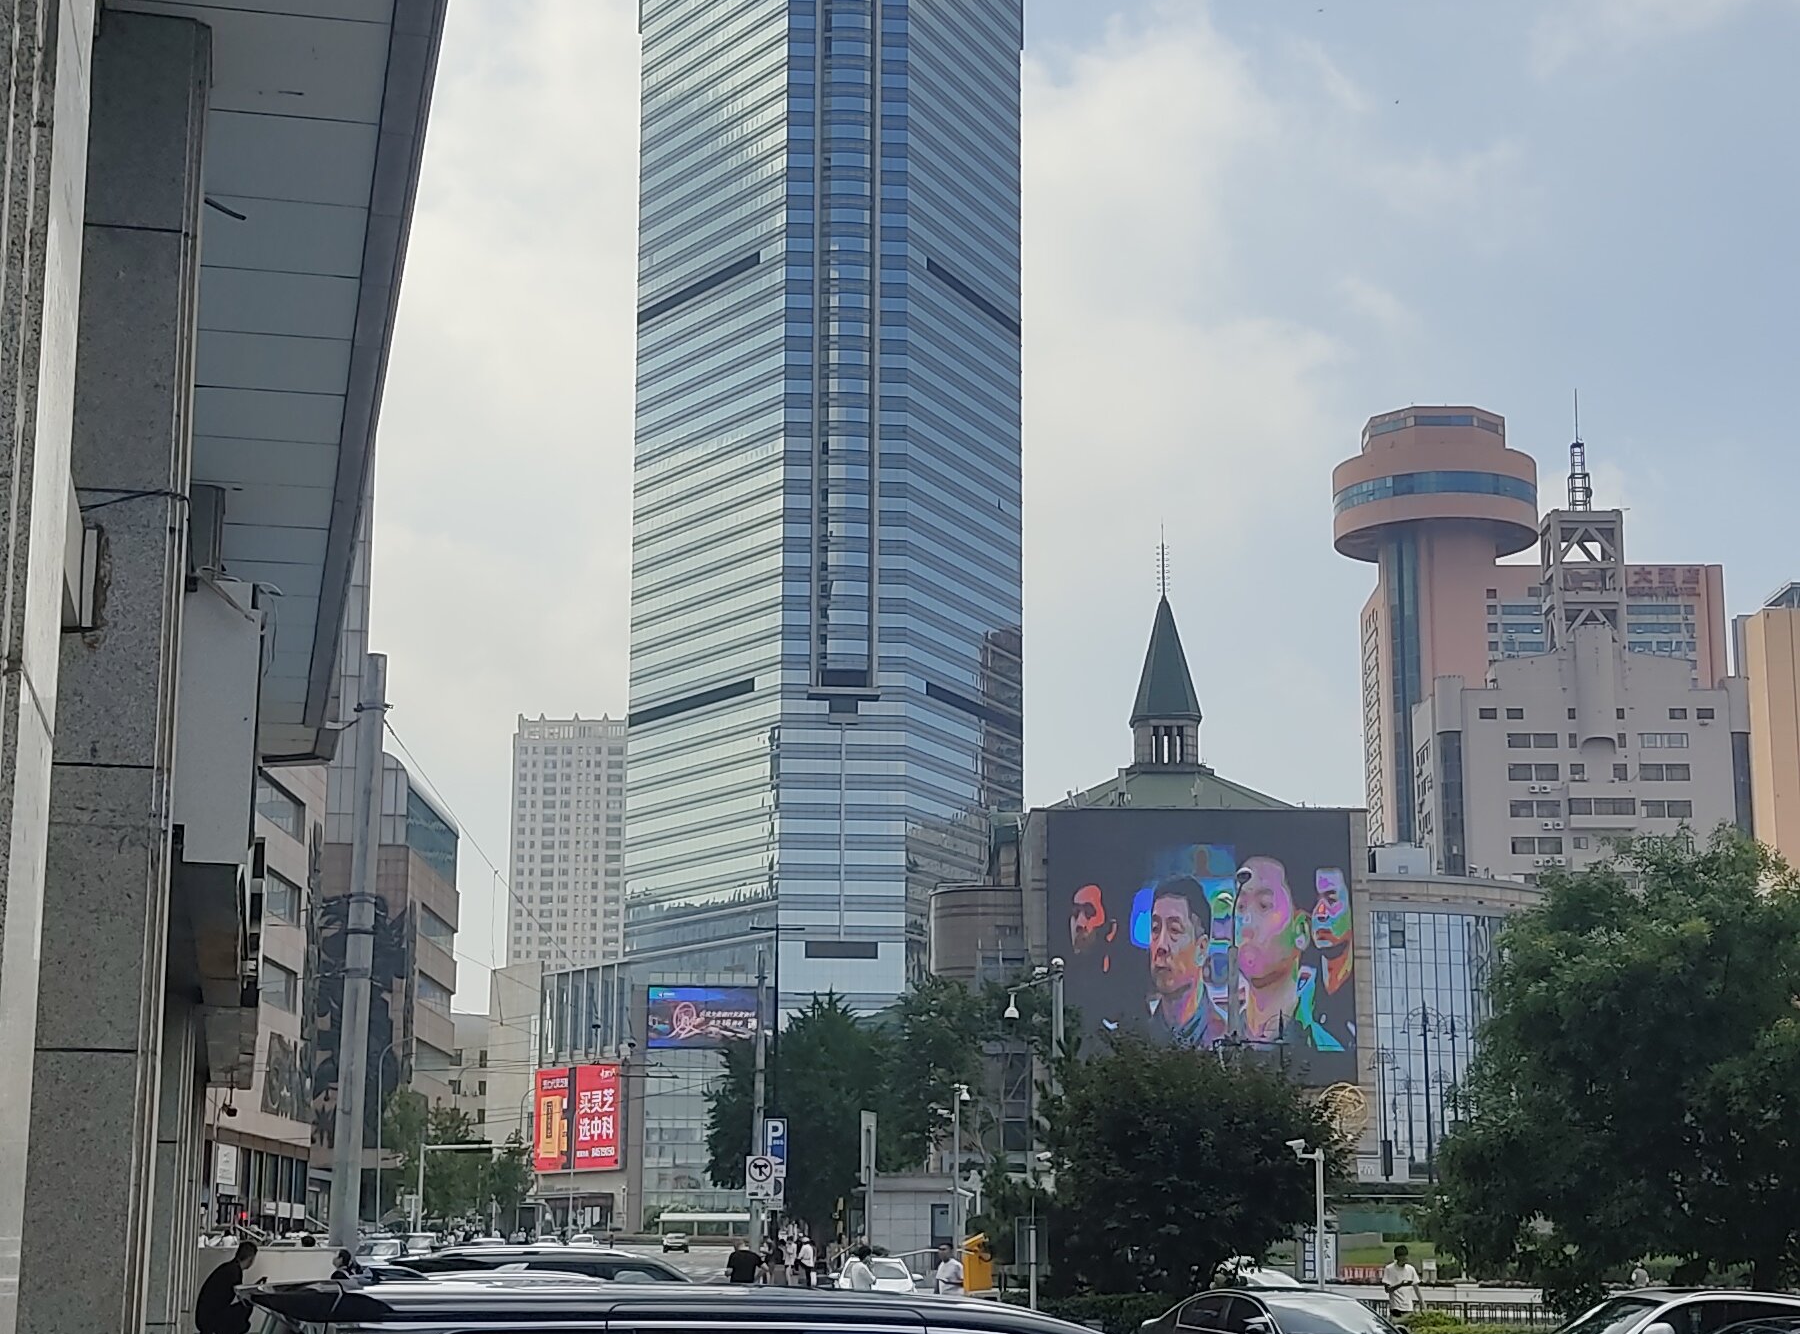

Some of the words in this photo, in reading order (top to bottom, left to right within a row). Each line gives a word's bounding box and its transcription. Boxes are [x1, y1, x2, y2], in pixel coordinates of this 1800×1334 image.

[579, 1088, 614, 1114] 买灵芝
[578, 1115, 614, 1141] 选中科
[767, 1120, 784, 1146] P
